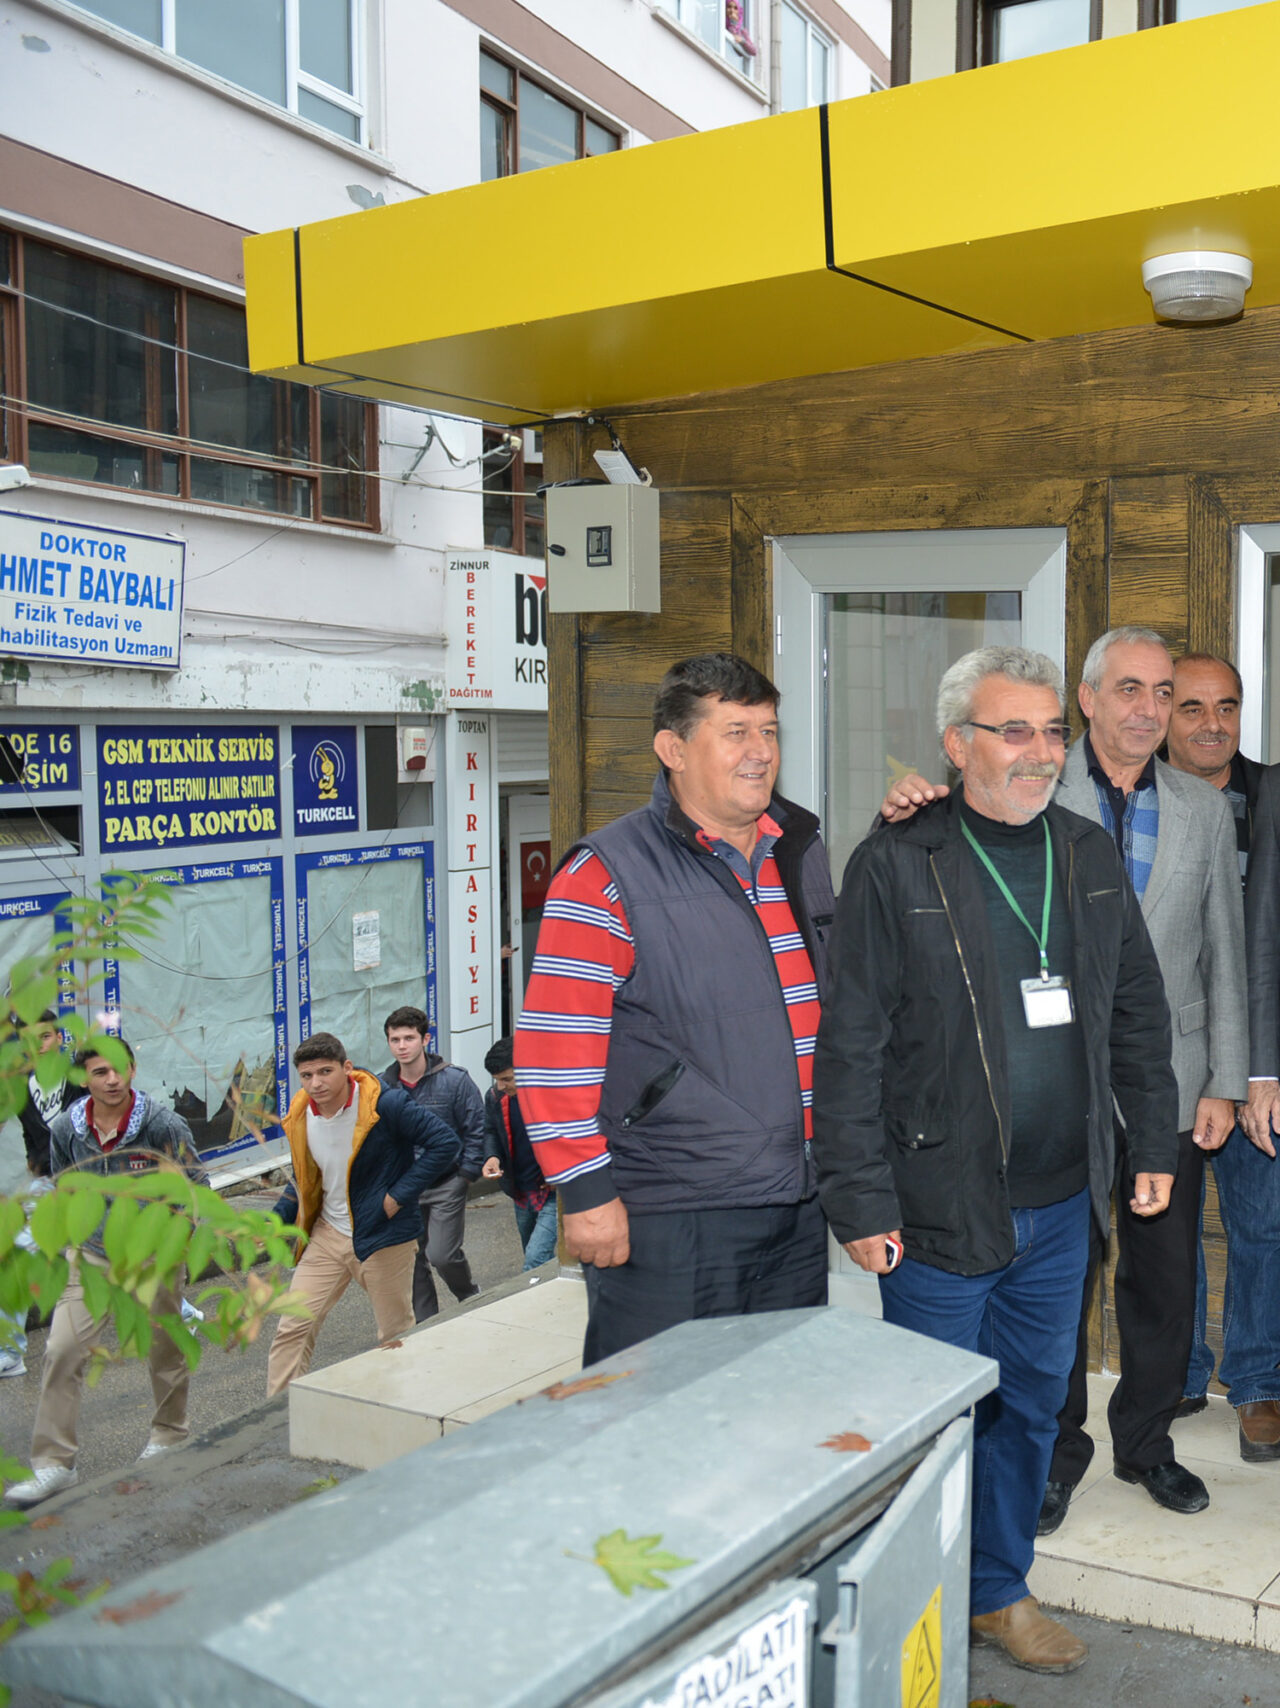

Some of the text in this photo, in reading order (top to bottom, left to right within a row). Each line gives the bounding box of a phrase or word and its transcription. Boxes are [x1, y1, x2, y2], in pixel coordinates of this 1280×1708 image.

[40, 531, 127, 562] DOKTOR
[450, 559, 489, 571] ZİNNUR
[0, 553, 175, 611] HMET BAYBALI
[15, 602, 143, 632] Fizik Tedavi ve
[466, 572, 476, 685] BEREKET
[0, 626, 173, 658] habilitasyon Uzmanı
[449, 686, 493, 698] DAĞITIM
[457, 720, 487, 734] TOPTAN
[0, 733, 73, 754] DE 16
[103, 732, 274, 765] GSM TEKNİK SERVİS
[104, 775, 275, 806] 2. EL CEP TELEFONU ALINIR SATILIR
[105, 803, 277, 846] PARÇA KONTÖR
[297, 806, 356, 824] TURKCELL
[466, 752, 480, 1015] KIRTASİYE
